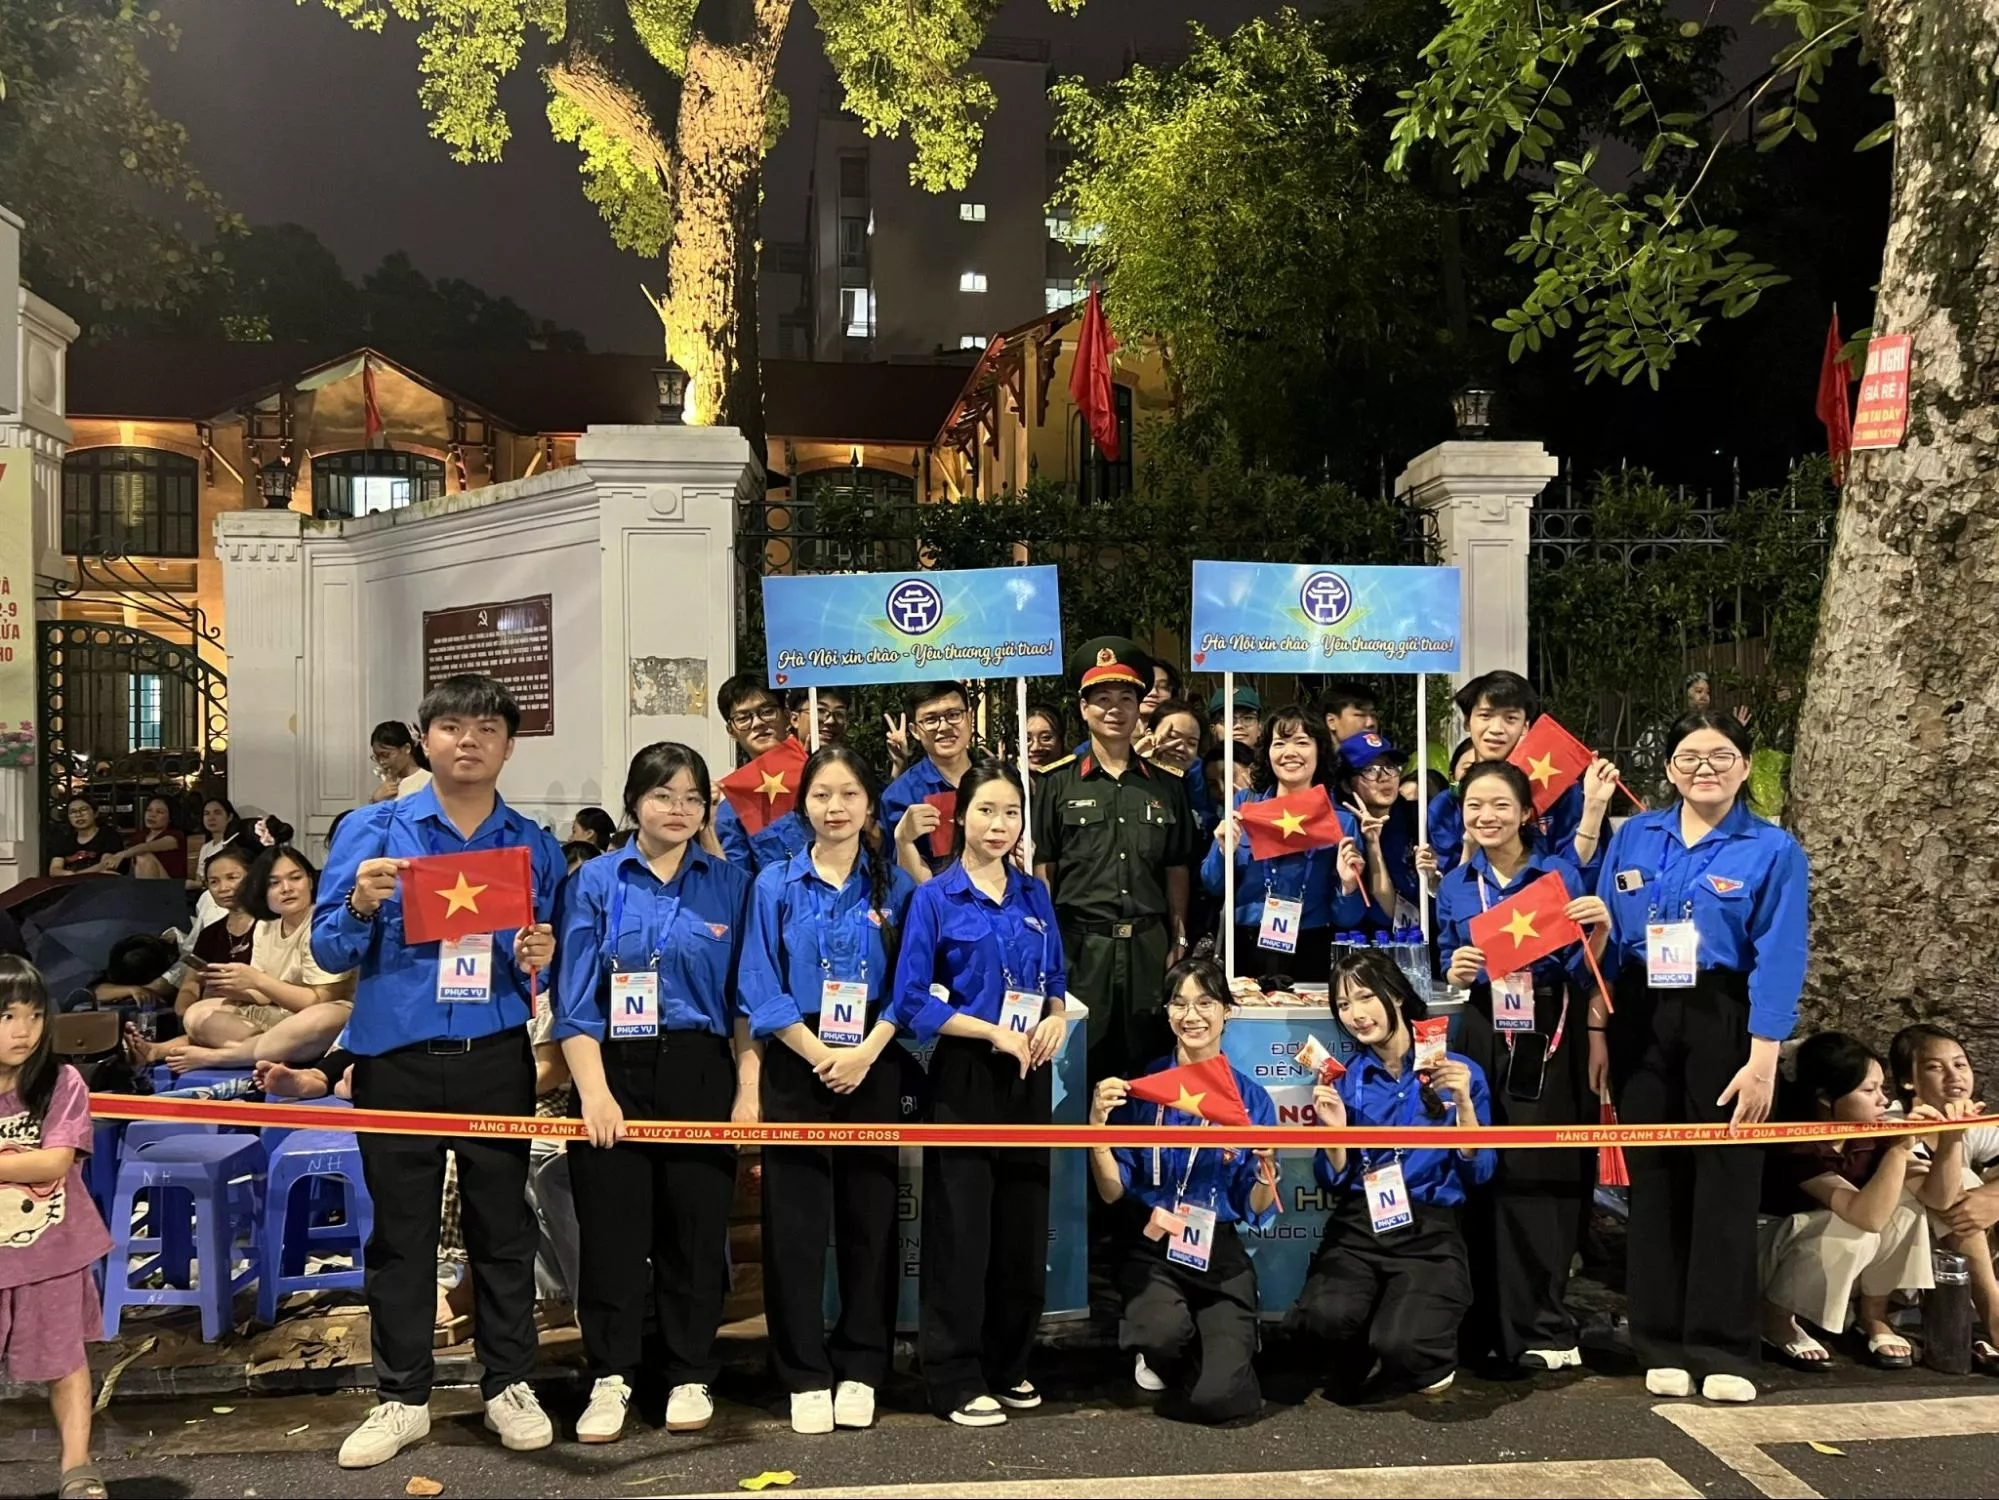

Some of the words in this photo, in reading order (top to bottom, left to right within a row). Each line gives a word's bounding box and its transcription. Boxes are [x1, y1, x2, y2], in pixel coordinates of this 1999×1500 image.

[0, 576, 10, 595] À
[0, 619, 20, 639] ỬA
[777, 649, 806, 670] Hà
[808, 647, 839, 668] Nội
[840, 648, 864, 667] xin
[866, 646, 900, 664] chào
[911, 643, 942, 668] Yêu
[944, 644, 991, 667] thương
[1017, 638, 1054, 656] trao!
[1201, 632, 1227, 652] Hà
[1229, 633, 1257, 653] Nội
[1257, 635, 1277, 652] xin
[1280, 634, 1310, 652] chào
[1321, 634, 1350, 658] Yêu
[1351, 635, 1395, 660] thương
[1419, 636, 1455, 652] trao!
[1272, 917, 1288, 933] N
[1662, 946, 1680, 964] N
[456, 958, 475, 976] N
[444, 988, 469, 998] PHỤC
[470, 988, 484, 998] VỤ
[1505, 994, 1521, 1009] N
[626, 996, 643, 1014] N
[834, 1004, 852, 1022] N
[616, 1025, 640, 1034] PHỤC
[640, 1025, 653, 1034] VỤ
[1010, 1014, 1027, 1032] N
[823, 1032, 845, 1042] PHỤC
[845, 1034, 858, 1043] VỤ
[469, 1120, 506, 1132] HÀNG
[509, 1121, 537, 1133] RÀO
[643, 1128, 682, 1140] VƯỢT
[685, 1129, 712, 1138] QUA
[723, 1129, 769, 1139] POLICE
[772, 1131, 804, 1139] LINE.
[808, 1131, 825, 1140] DO
[829, 1131, 854, 1140] NOT
[858, 1131, 900, 1140] CROSS
[1556, 1129, 1589, 1141] HÀNG
[1592, 1128, 1617, 1141] RÀO
[1752, 1128, 1776, 1138] QUA
[1787, 1125, 1827, 1136] POLICE
[1379, 1189, 1396, 1208] N
[1377, 1217, 1396, 1228] PHỤC
[1183, 1226, 1200, 1245] N
